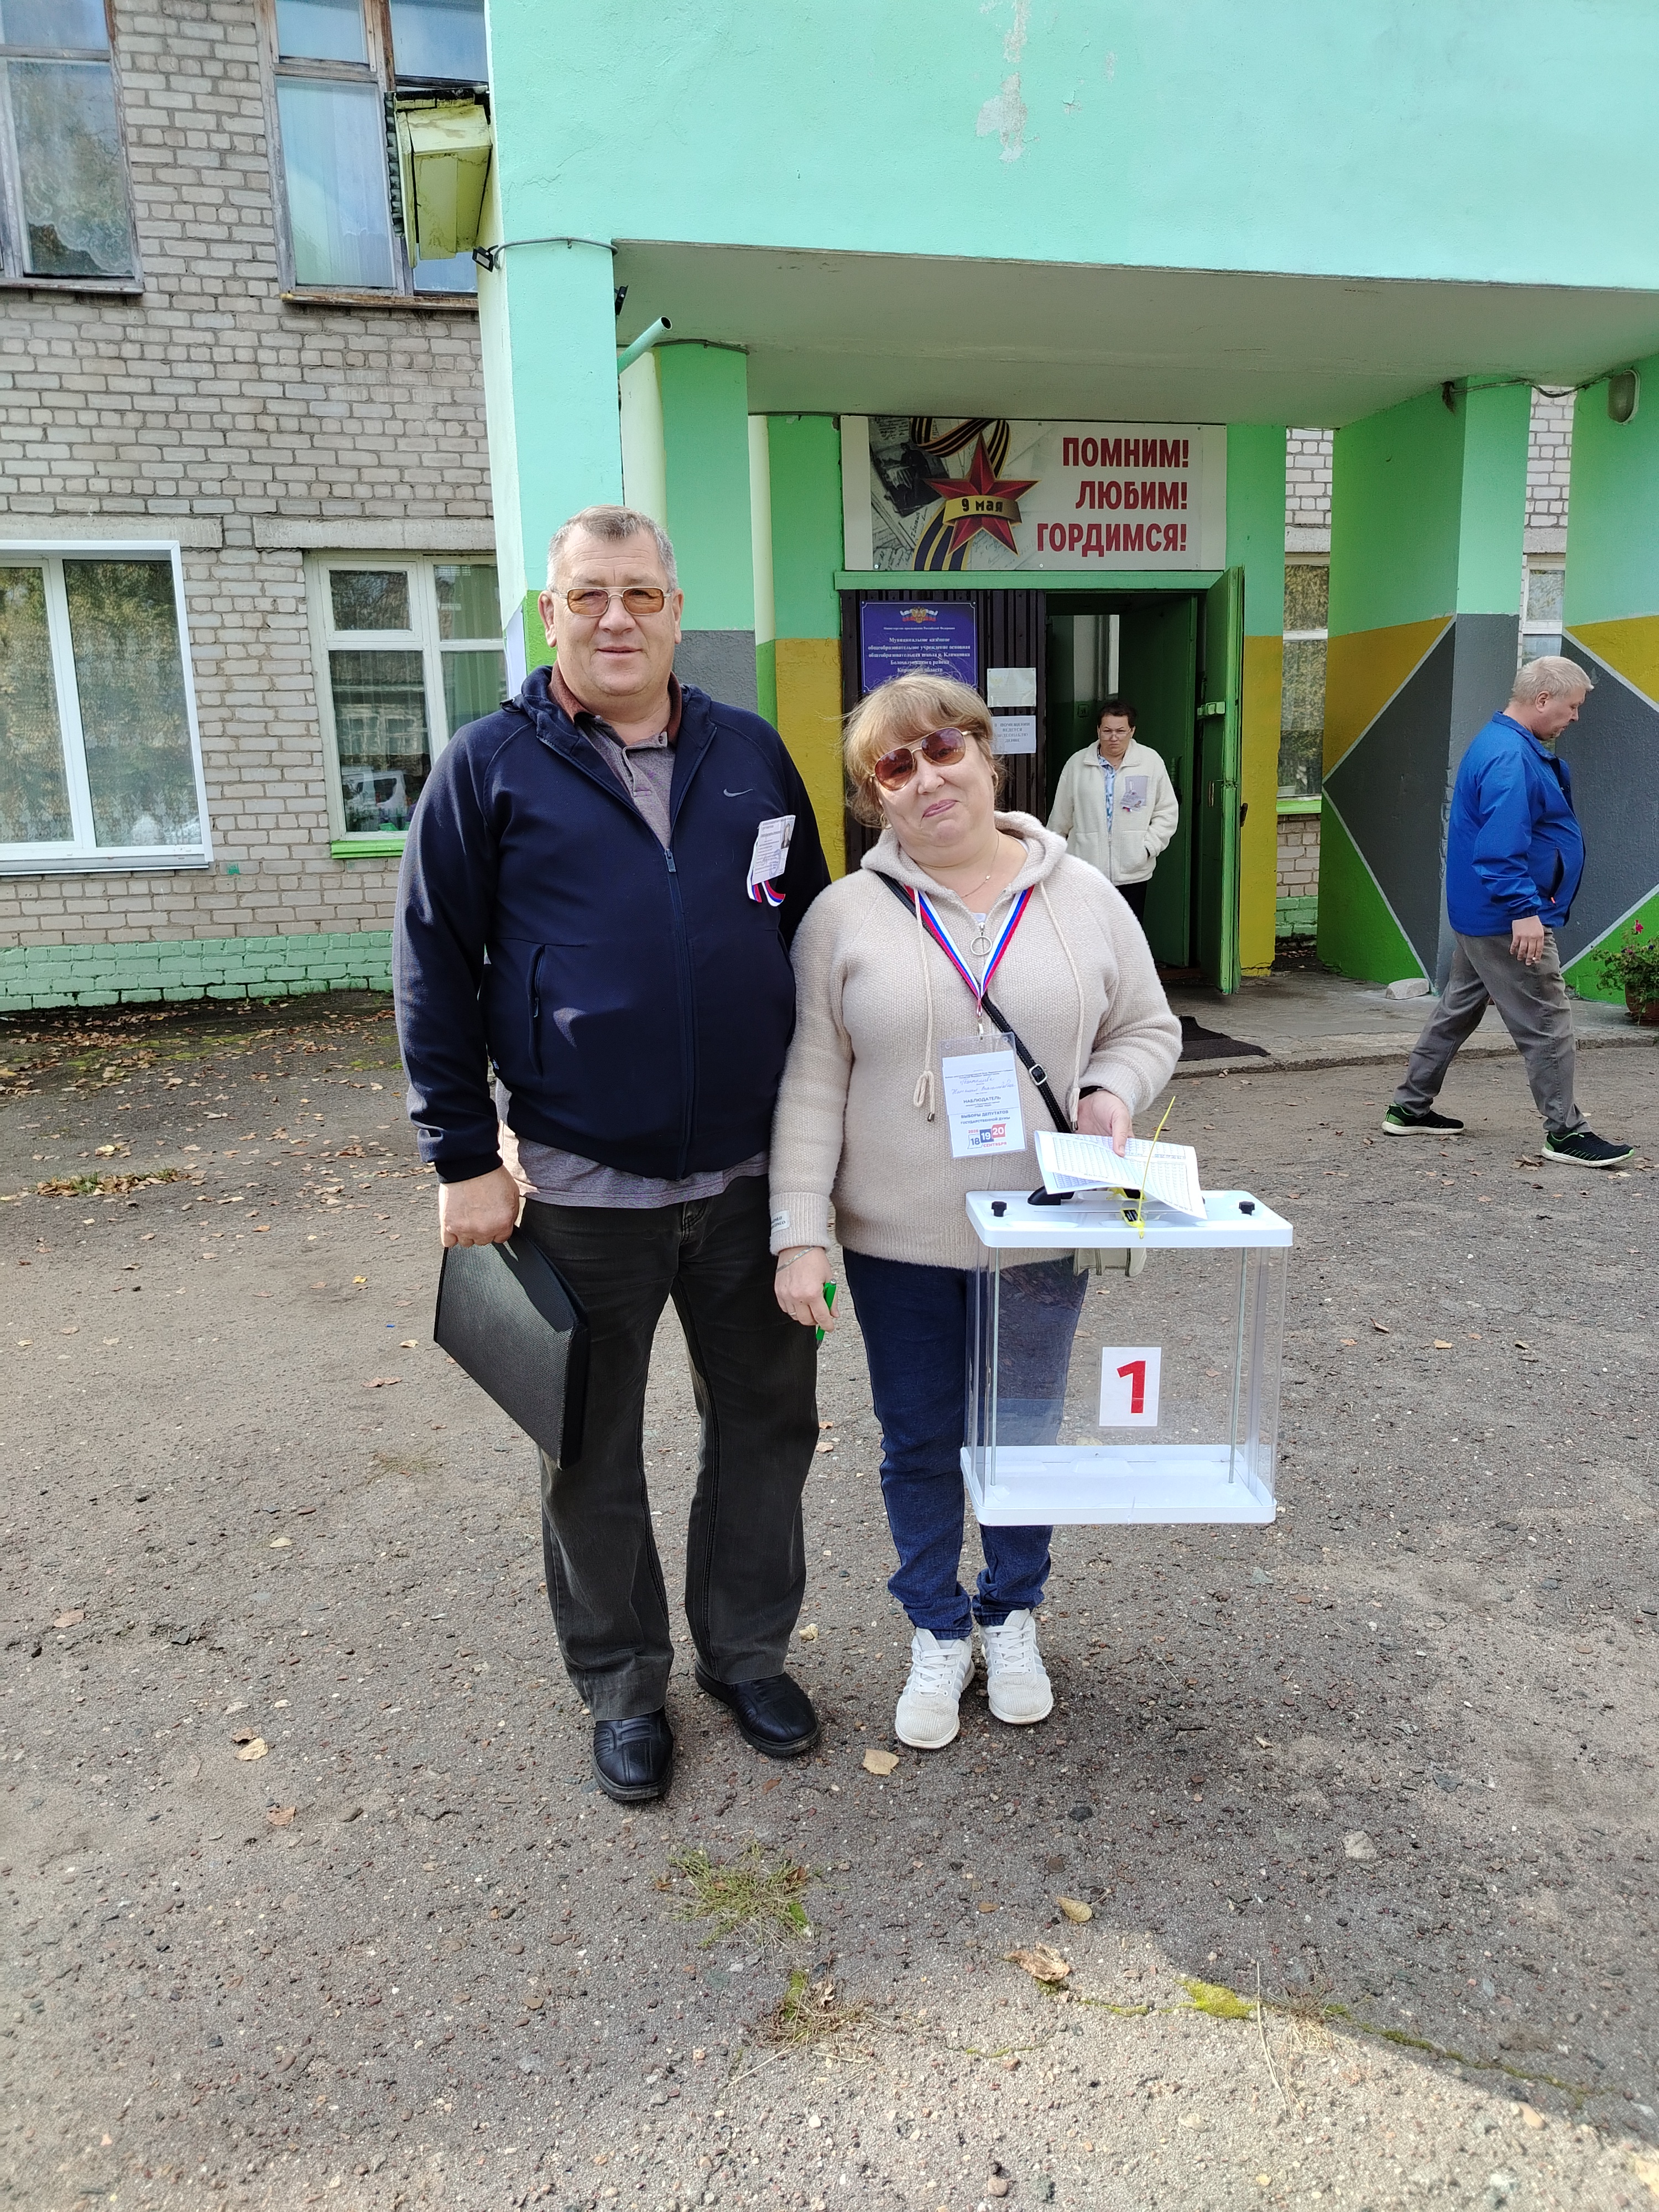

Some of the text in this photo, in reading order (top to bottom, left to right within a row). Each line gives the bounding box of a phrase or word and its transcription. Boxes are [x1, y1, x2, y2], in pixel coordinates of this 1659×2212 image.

[1063, 437, 1188, 467] ПОМНИМ!
[962, 498, 1003, 512] 9 мая
[1076, 481, 1187, 510] ЛЮБИМ!
[1037, 523, 1187, 557] ГОРДИМСЯ!
[981, 1132, 991, 1140] 19
[992, 1127, 1004, 1135] 20
[1117, 1360, 1146, 1413] 1
